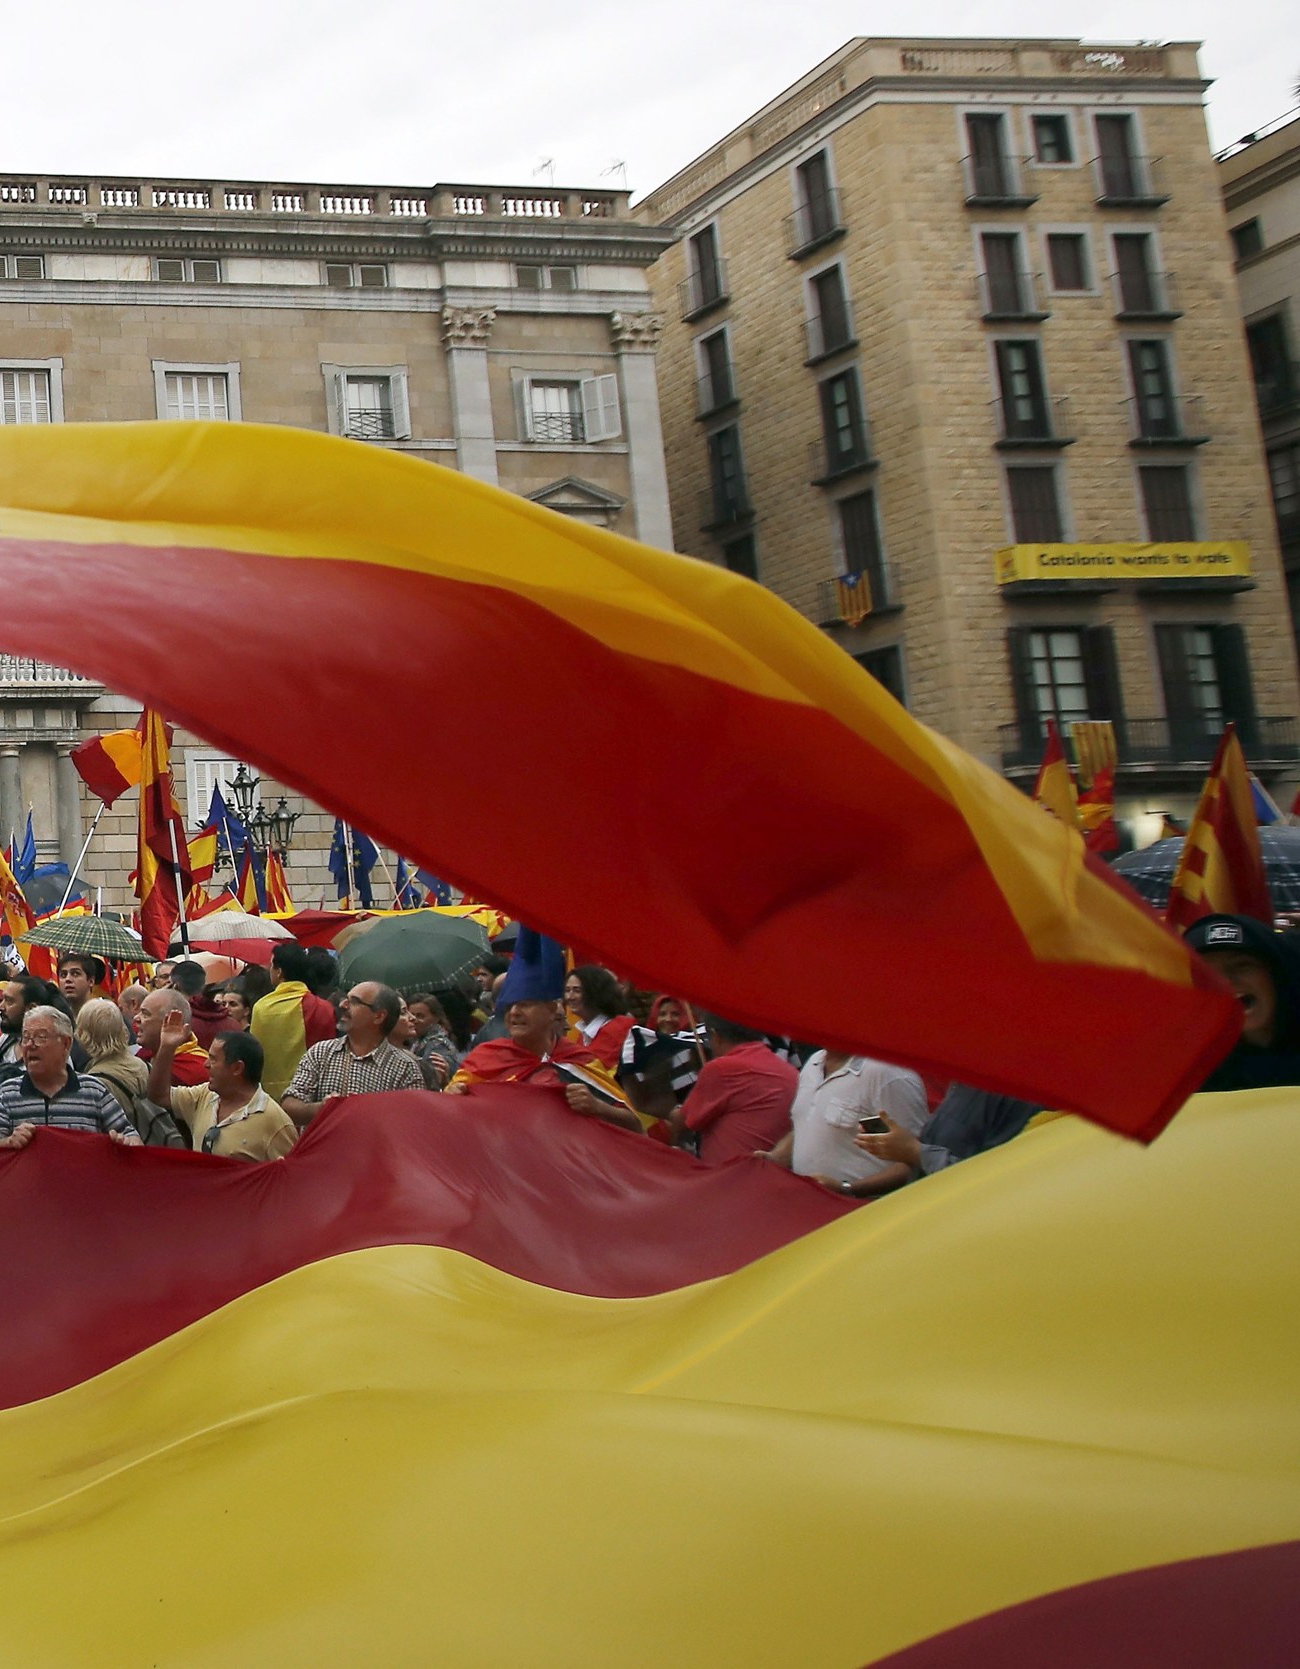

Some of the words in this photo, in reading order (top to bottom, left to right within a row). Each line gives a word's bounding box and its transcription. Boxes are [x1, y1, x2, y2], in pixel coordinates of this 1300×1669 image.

[1038, 553, 1116, 566] Catalonia
[1122, 553, 1170, 565] wants
[1172, 553, 1190, 564] to
